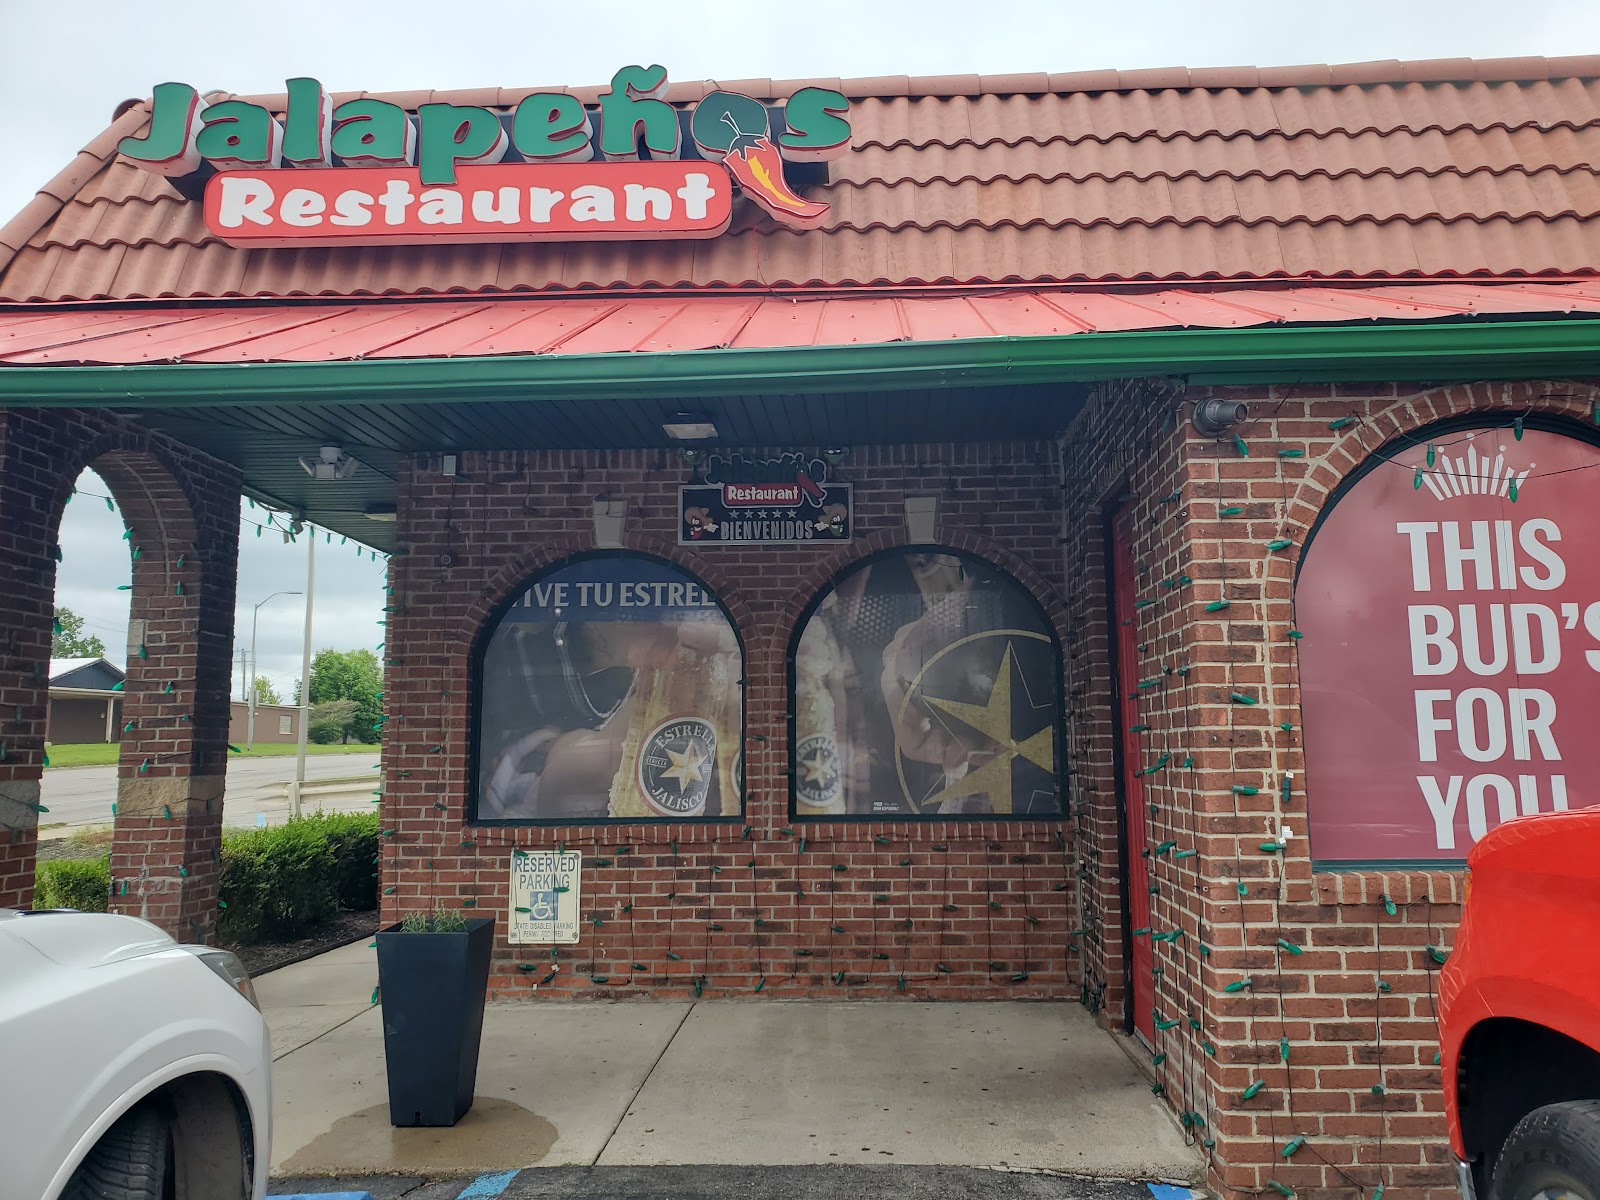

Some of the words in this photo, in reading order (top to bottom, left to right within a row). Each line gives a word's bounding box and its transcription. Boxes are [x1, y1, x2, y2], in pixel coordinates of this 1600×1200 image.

[117, 64, 852, 188] Jalapeños
[217, 172, 717, 230] Restaurant
[727, 485, 799, 501] Restaurant
[720, 520, 814, 540] BIENVENIDOS
[1396, 517, 1567, 592] THIS
[512, 582, 570, 608] IVE
[575, 582, 614, 608] TU
[1413, 687, 1563, 763] FOR
[651, 786, 704, 811] JALISCO
[515, 857, 576, 873] RESERVED
[519, 873, 570, 890] PARKING
